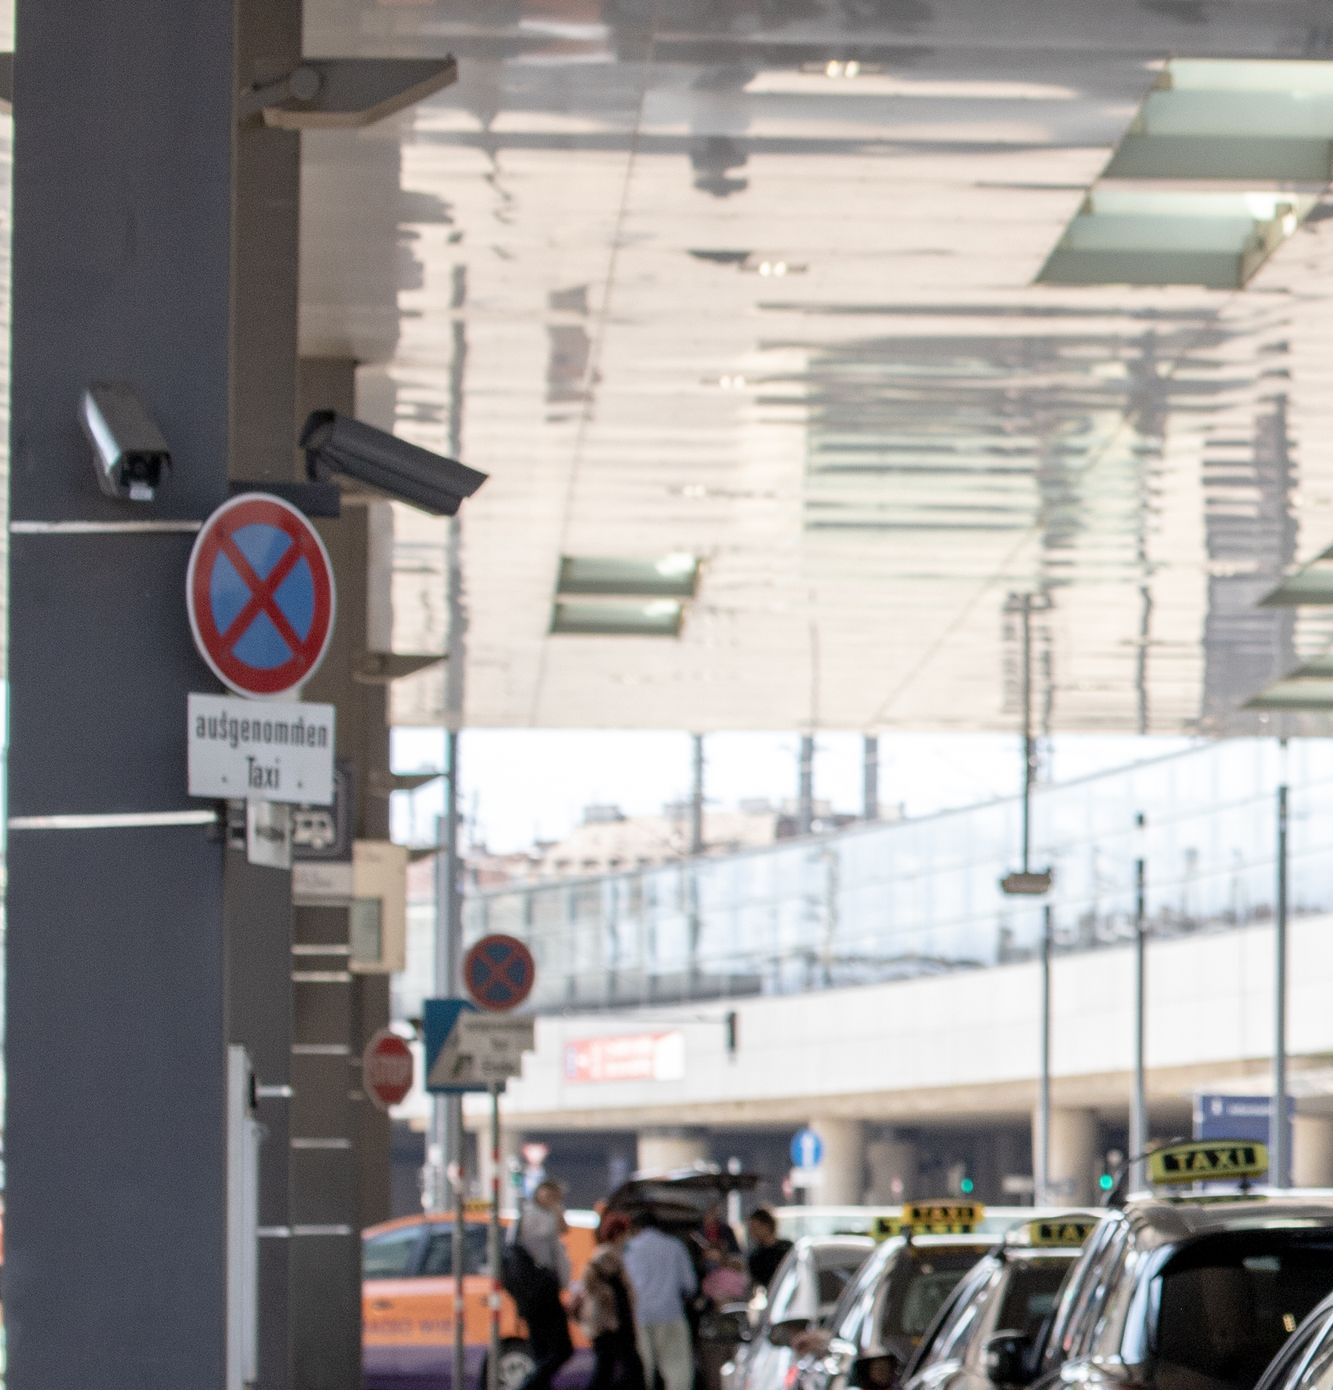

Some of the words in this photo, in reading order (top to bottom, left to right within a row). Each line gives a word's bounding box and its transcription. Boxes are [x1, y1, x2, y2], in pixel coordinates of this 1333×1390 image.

[196, 712, 328, 749] ausgenommen
[247, 755, 280, 790] Taxi
[1170, 1148, 1247, 1172] TAXI
